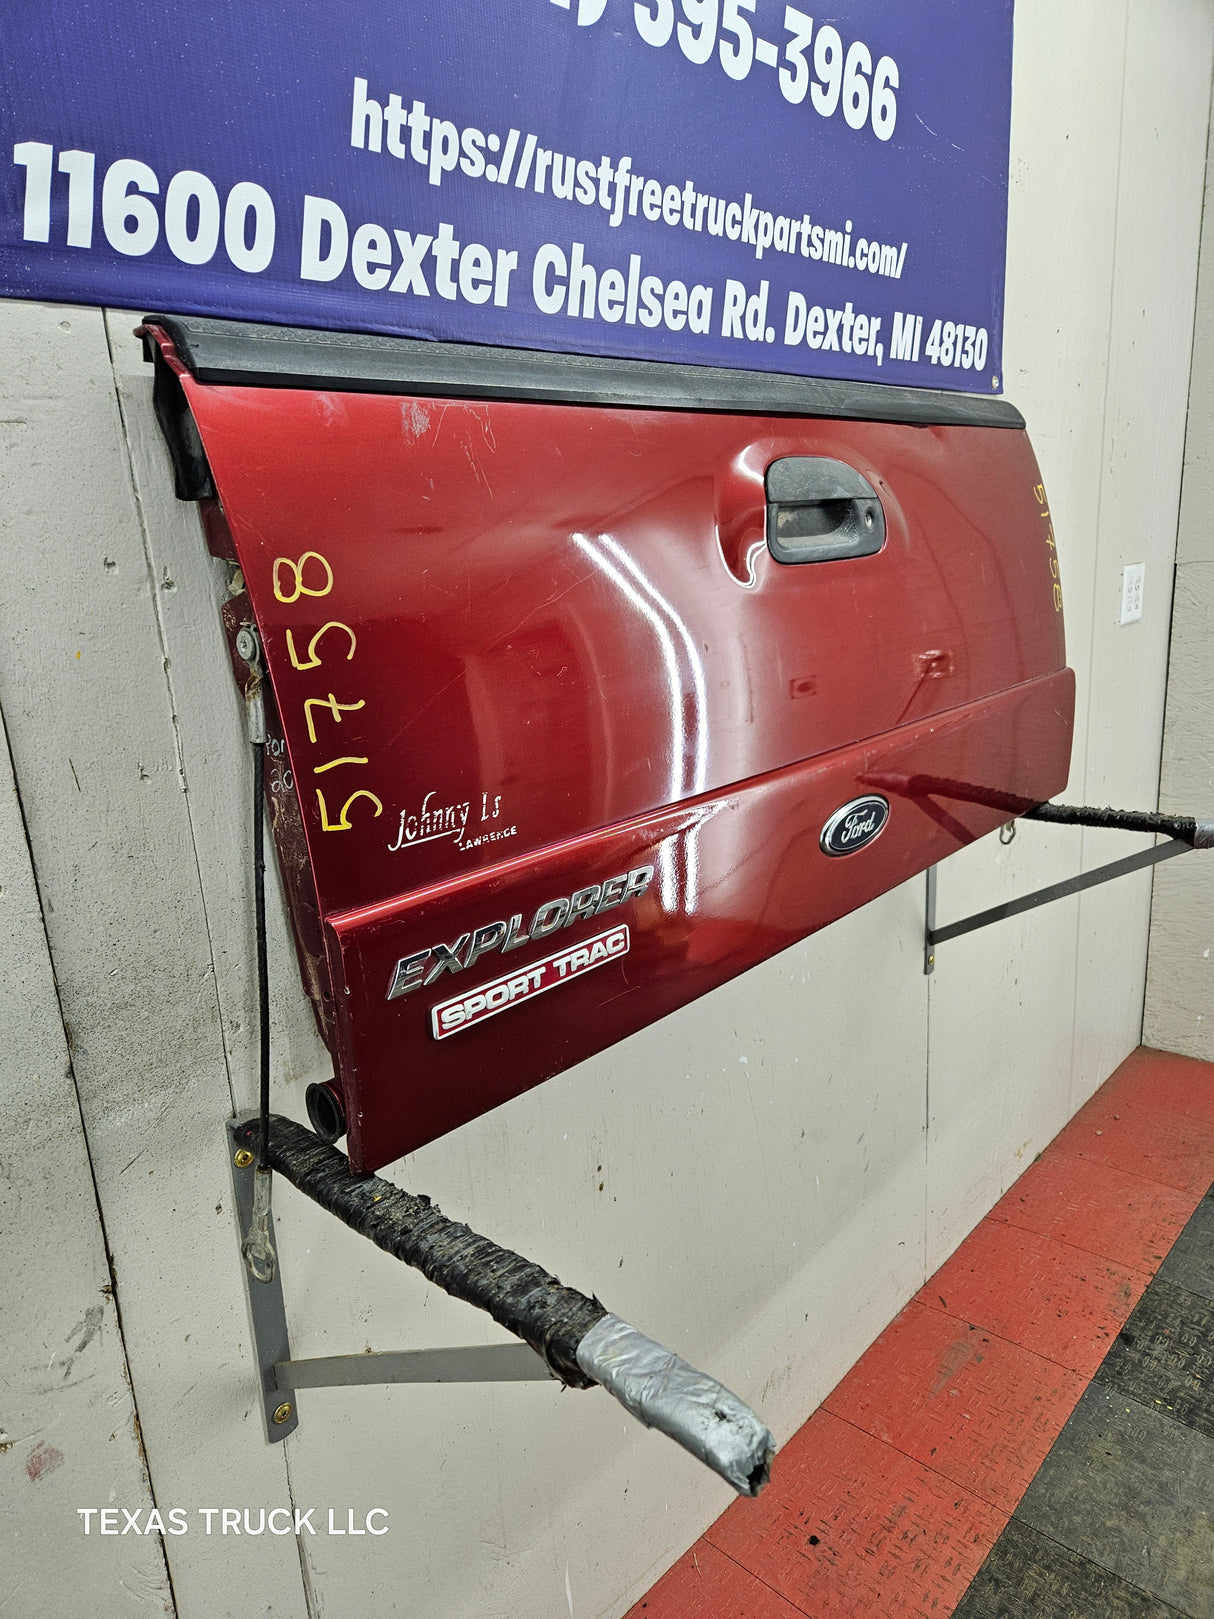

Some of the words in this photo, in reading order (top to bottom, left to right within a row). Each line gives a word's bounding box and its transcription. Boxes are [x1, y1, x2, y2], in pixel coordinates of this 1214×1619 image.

[351, 76, 908, 279] https://rustfreetruckpartsmi.com/
[14, 141, 276, 273] 11600
[300, 195, 518, 307] Dexter
[532, 242, 713, 335] Chelsea
[721, 279, 776, 344] Rd.
[783, 291, 884, 366] Dexter,
[890, 311, 923, 362] MI
[925, 319, 988, 371] 48130
[273, 551, 383, 832] 51758
[387, 791, 470, 851] Johnny
[841, 808, 876, 844] Ford
[386, 865, 654, 1000] EXPLORER
[440, 966, 546, 1030] SPORT
[552, 931, 625, 977] TRAC
